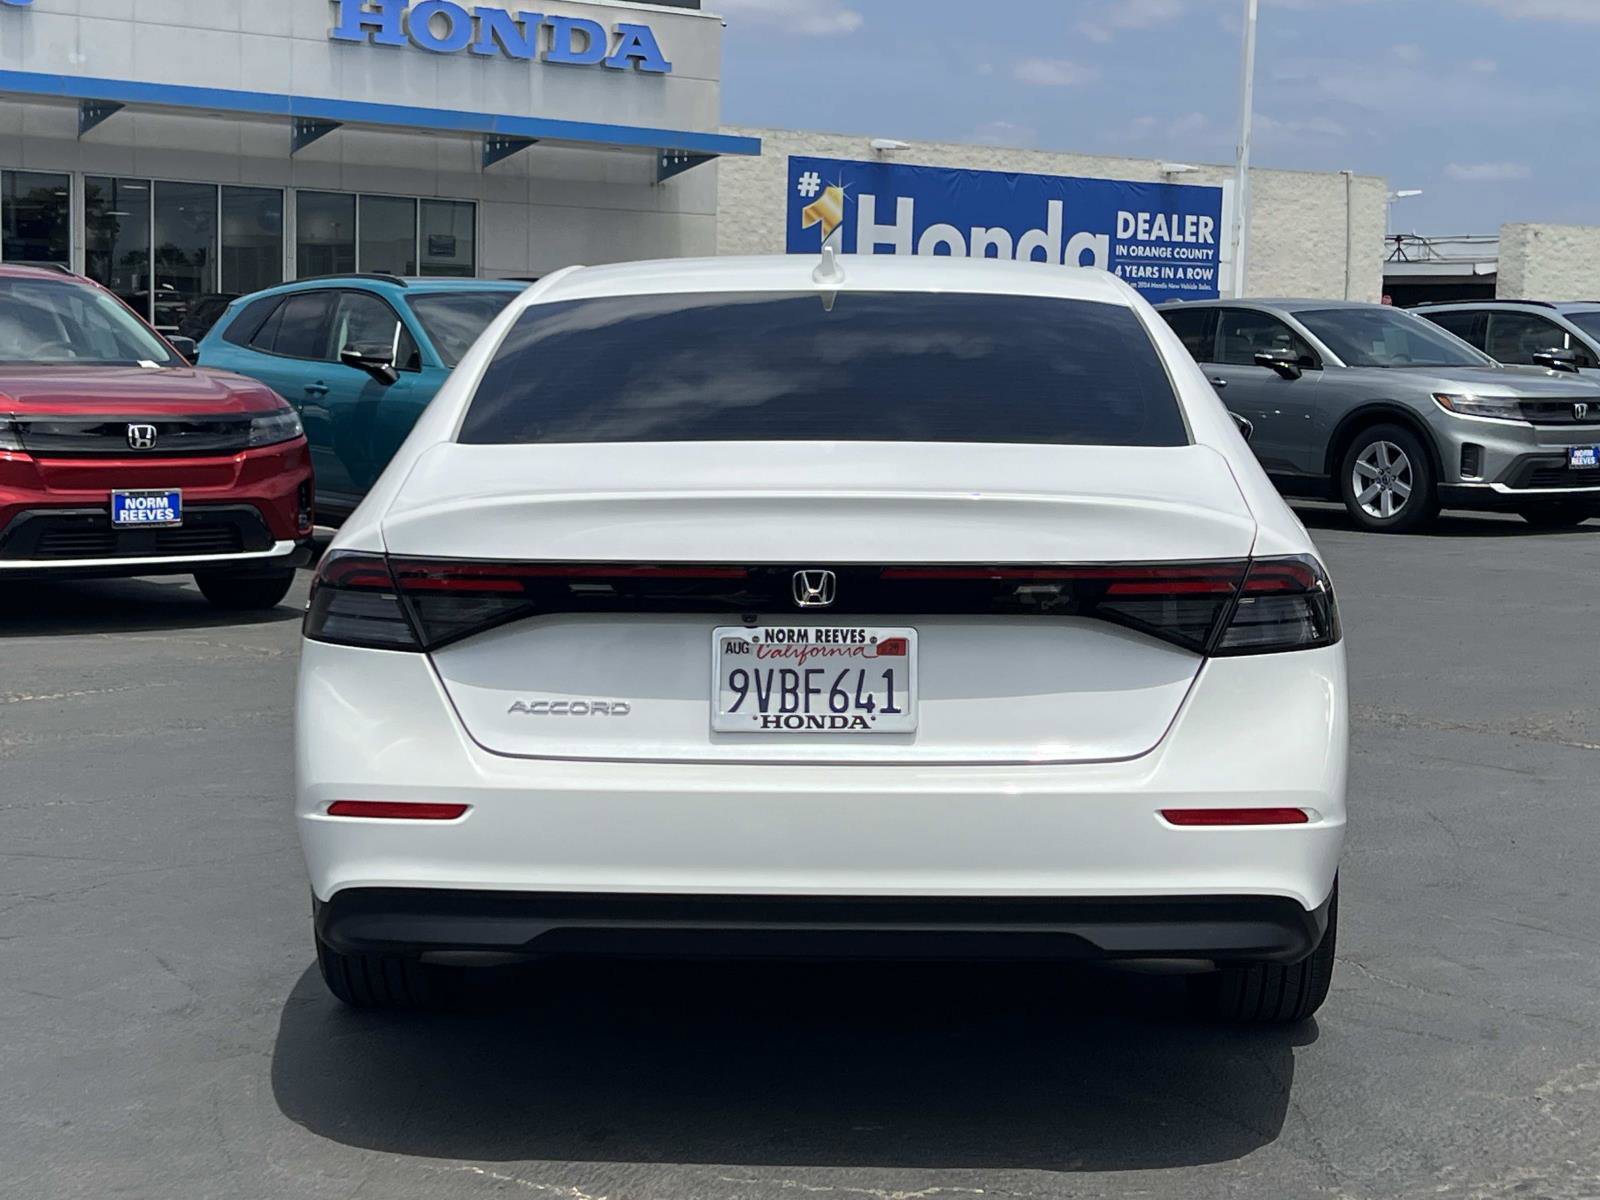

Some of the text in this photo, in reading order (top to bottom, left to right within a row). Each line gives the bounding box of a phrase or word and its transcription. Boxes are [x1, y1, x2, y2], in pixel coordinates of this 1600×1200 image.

[331, 0, 673, 74] HONDA
[1116, 210, 1215, 244] DEALER
[1115, 245, 1214, 260] IN ORANGE COUNTY
[1114, 265, 1214, 280] 4 YEARS IN A ROW
[125, 497, 169, 509] NORM
[119, 508, 175, 521] REEVES
[764, 629, 866, 643] NORM REEVES
[725, 641, 750, 655] AUG
[756, 644, 879, 666] California
[727, 668, 902, 714] 9VBF641
[507, 701, 631, 716] ACCORD
[760, 714, 872, 729] HONDA
